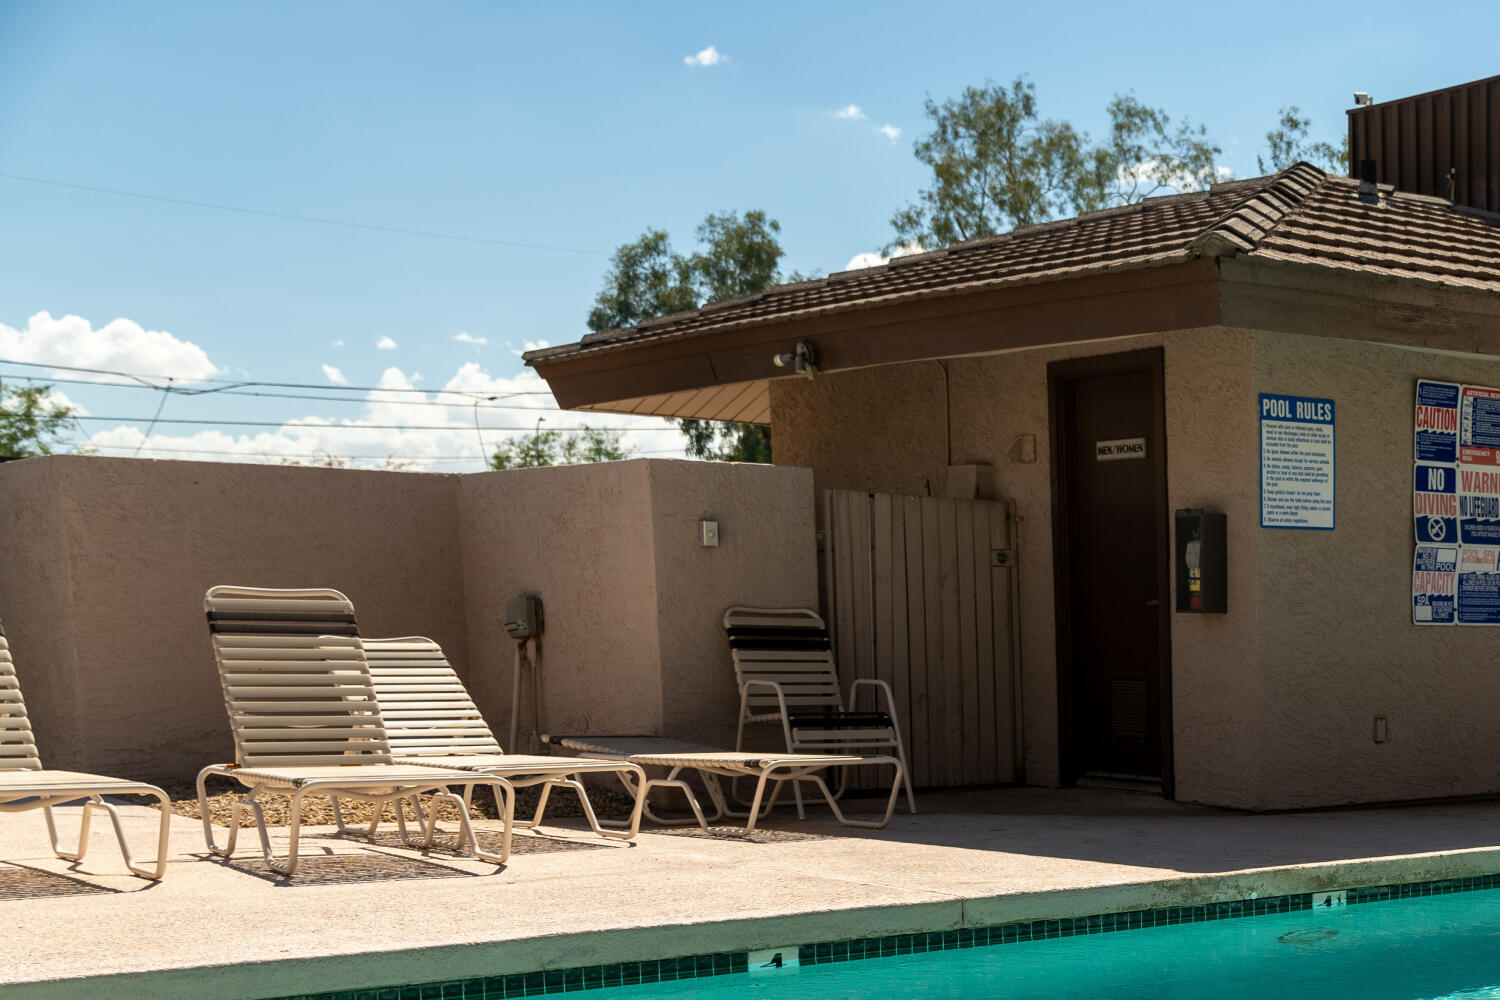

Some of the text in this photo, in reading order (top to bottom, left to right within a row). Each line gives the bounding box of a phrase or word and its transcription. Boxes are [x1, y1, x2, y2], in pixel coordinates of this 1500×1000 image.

[1262, 398, 1332, 421] POOL RULES
[1416, 405, 1458, 432] CAUTION
[1097, 443, 1144, 456] MEN/WOMEN
[1427, 467, 1445, 491] NO
[1415, 492, 1457, 516] DIVING
[1460, 495, 1468, 517] NO
[1469, 496, 1499, 519] LIFEGUARD
[1435, 562, 1456, 572] POOL
[1414, 571, 1456, 594] CAPACITY
[1416, 595, 1430, 606] SPA
